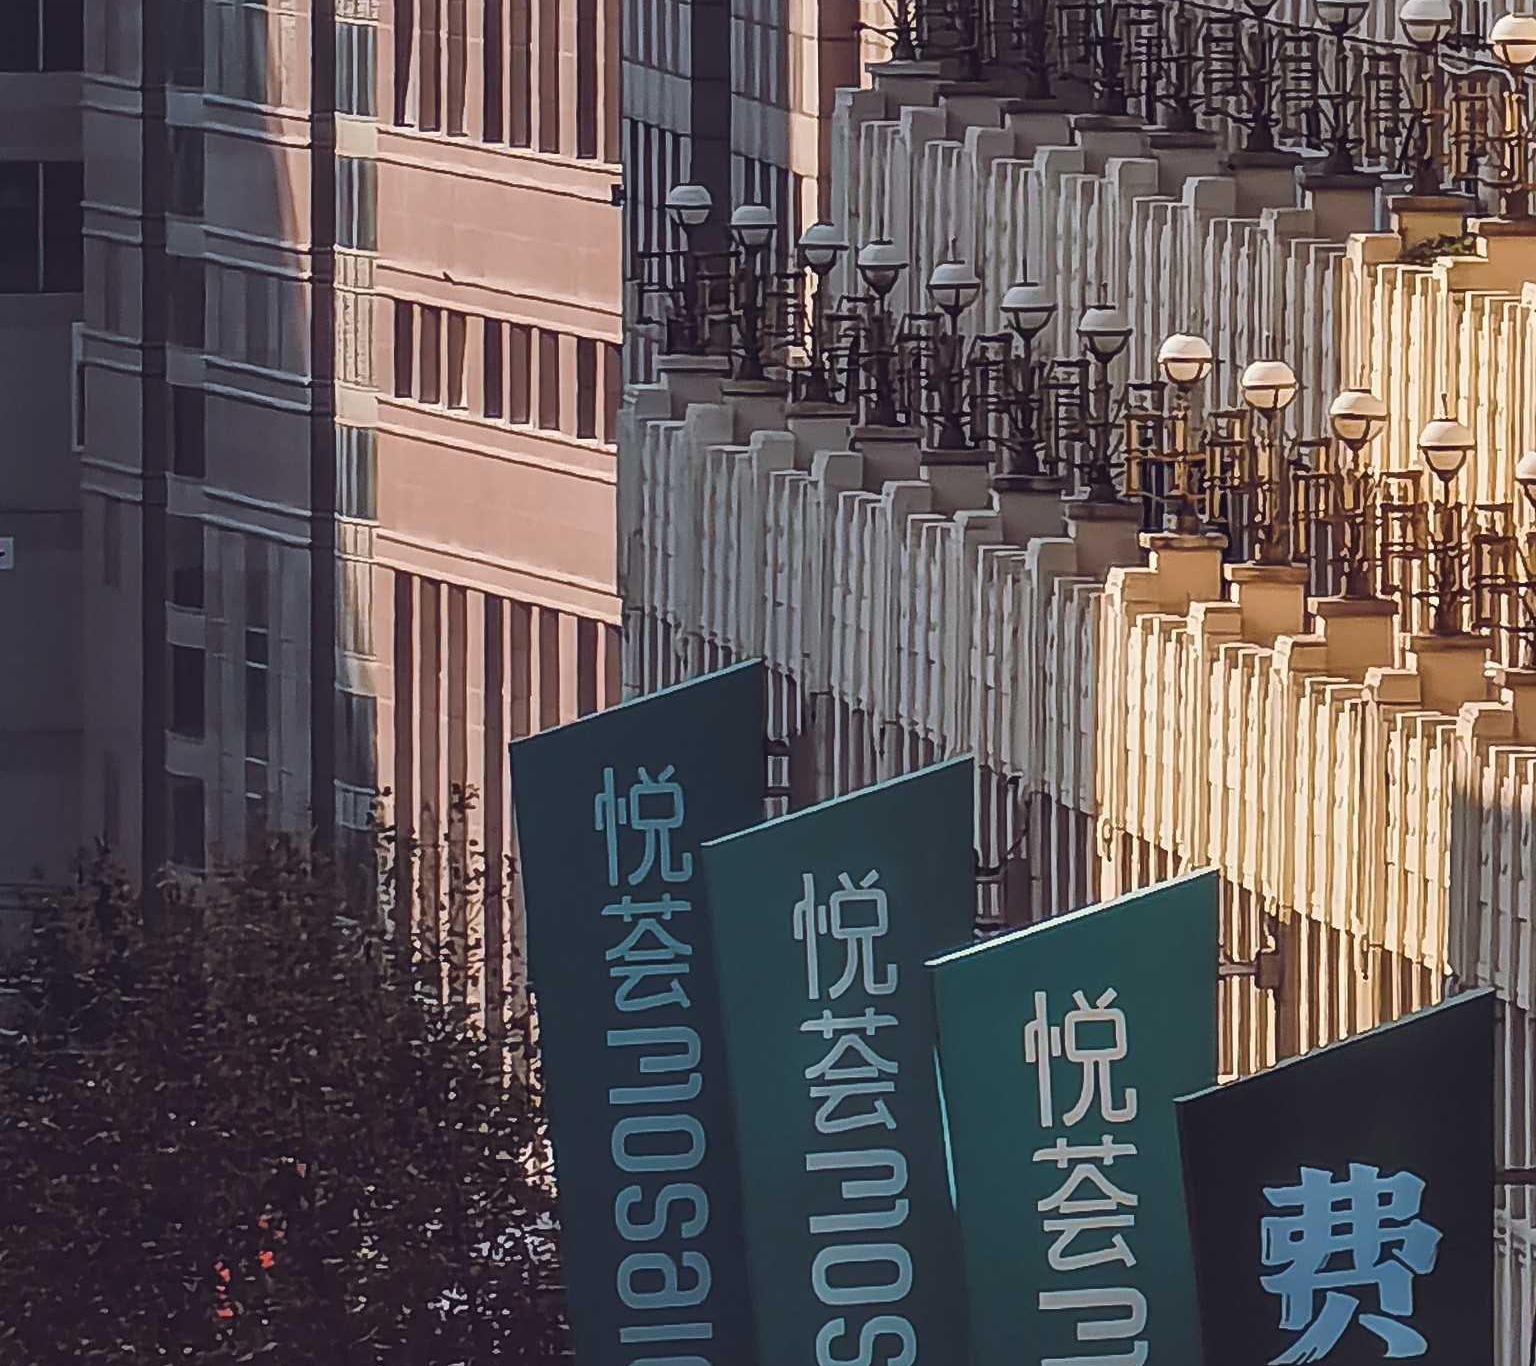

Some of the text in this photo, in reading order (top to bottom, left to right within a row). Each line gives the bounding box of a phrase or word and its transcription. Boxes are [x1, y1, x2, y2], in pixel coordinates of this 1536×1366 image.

[595, 764, 693, 1013] 悦荟
[793, 869, 899, 1134] 悦荟
[1024, 987, 1138, 1272] 悦荟
